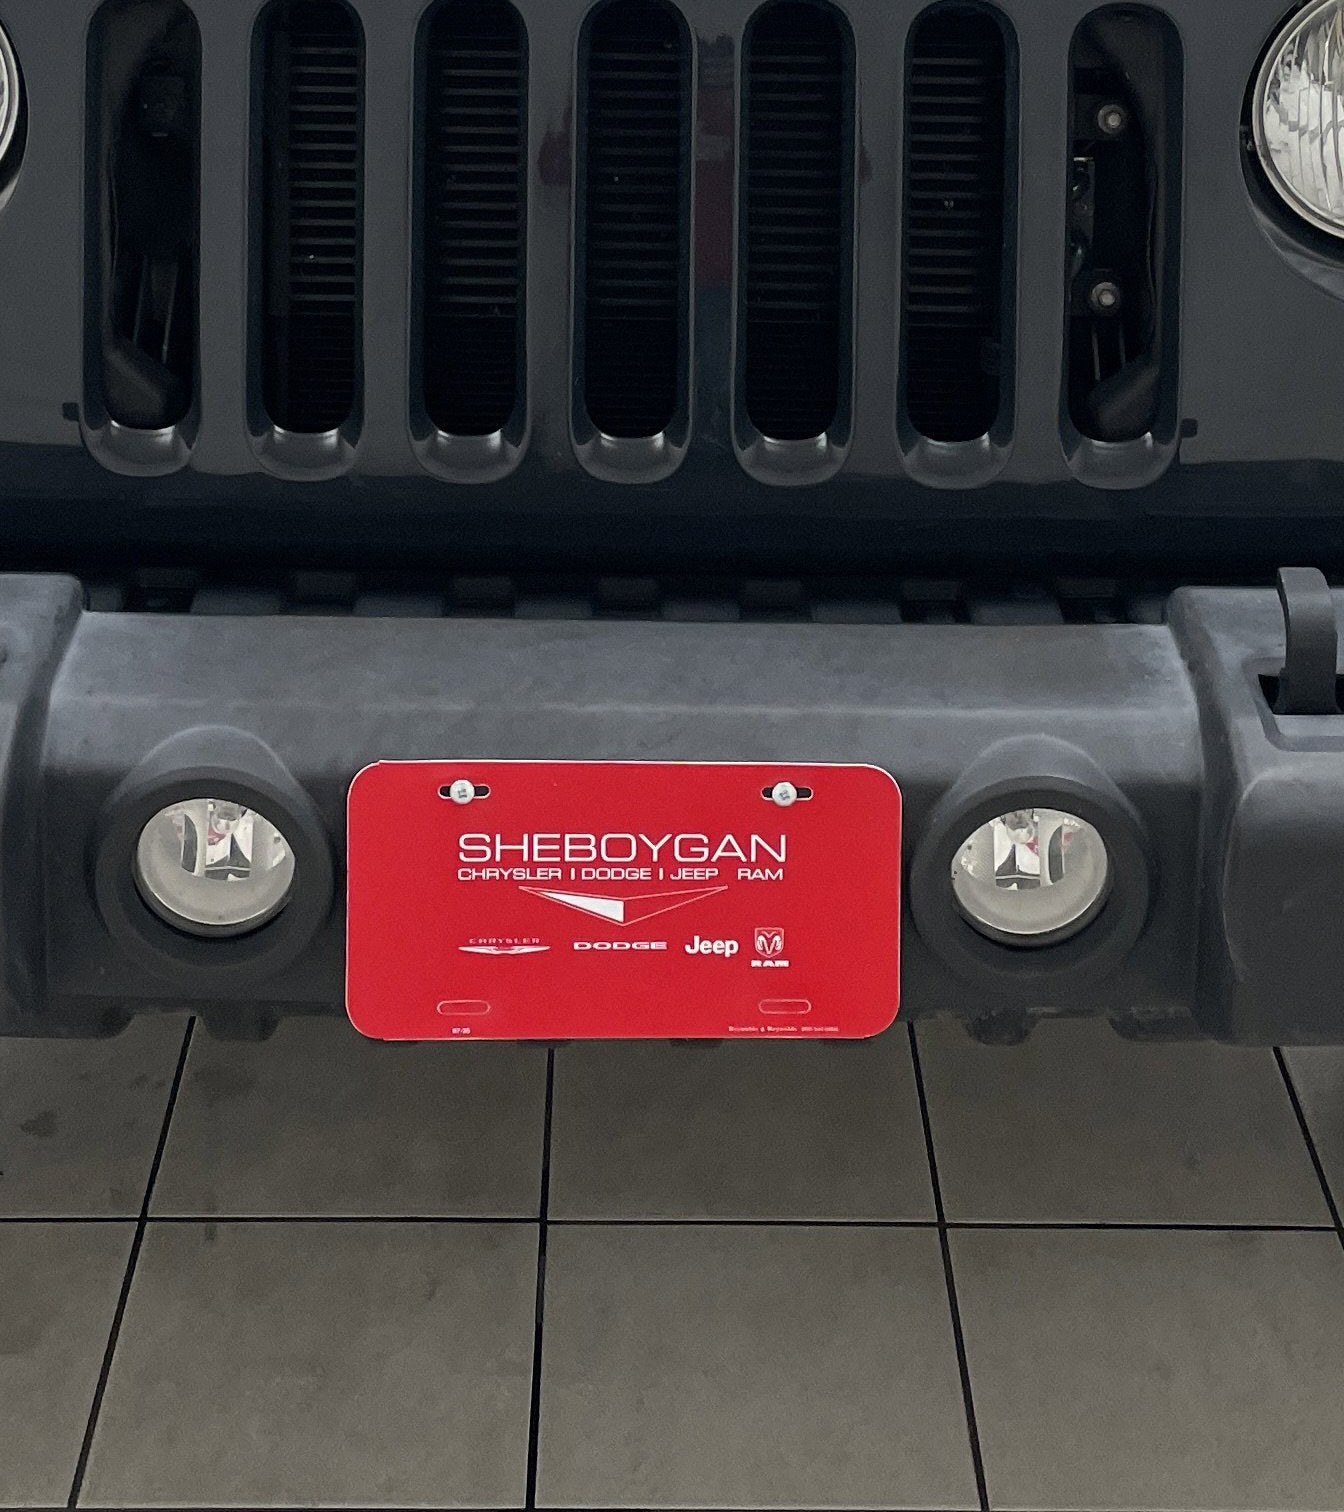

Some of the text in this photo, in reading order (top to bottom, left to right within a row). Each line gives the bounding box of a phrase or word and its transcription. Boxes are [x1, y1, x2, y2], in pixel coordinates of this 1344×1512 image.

[458, 833, 787, 863] SHEBOYGAN
[457, 867, 562, 881] CHRYSLER
[581, 867, 652, 881] DODGE
[670, 867, 719, 881] JEEP
[737, 868, 784, 881] RAM
[573, 941, 668, 951] DODGE
[684, 935, 739, 958] Jeep
[751, 959, 790, 968] RAM
